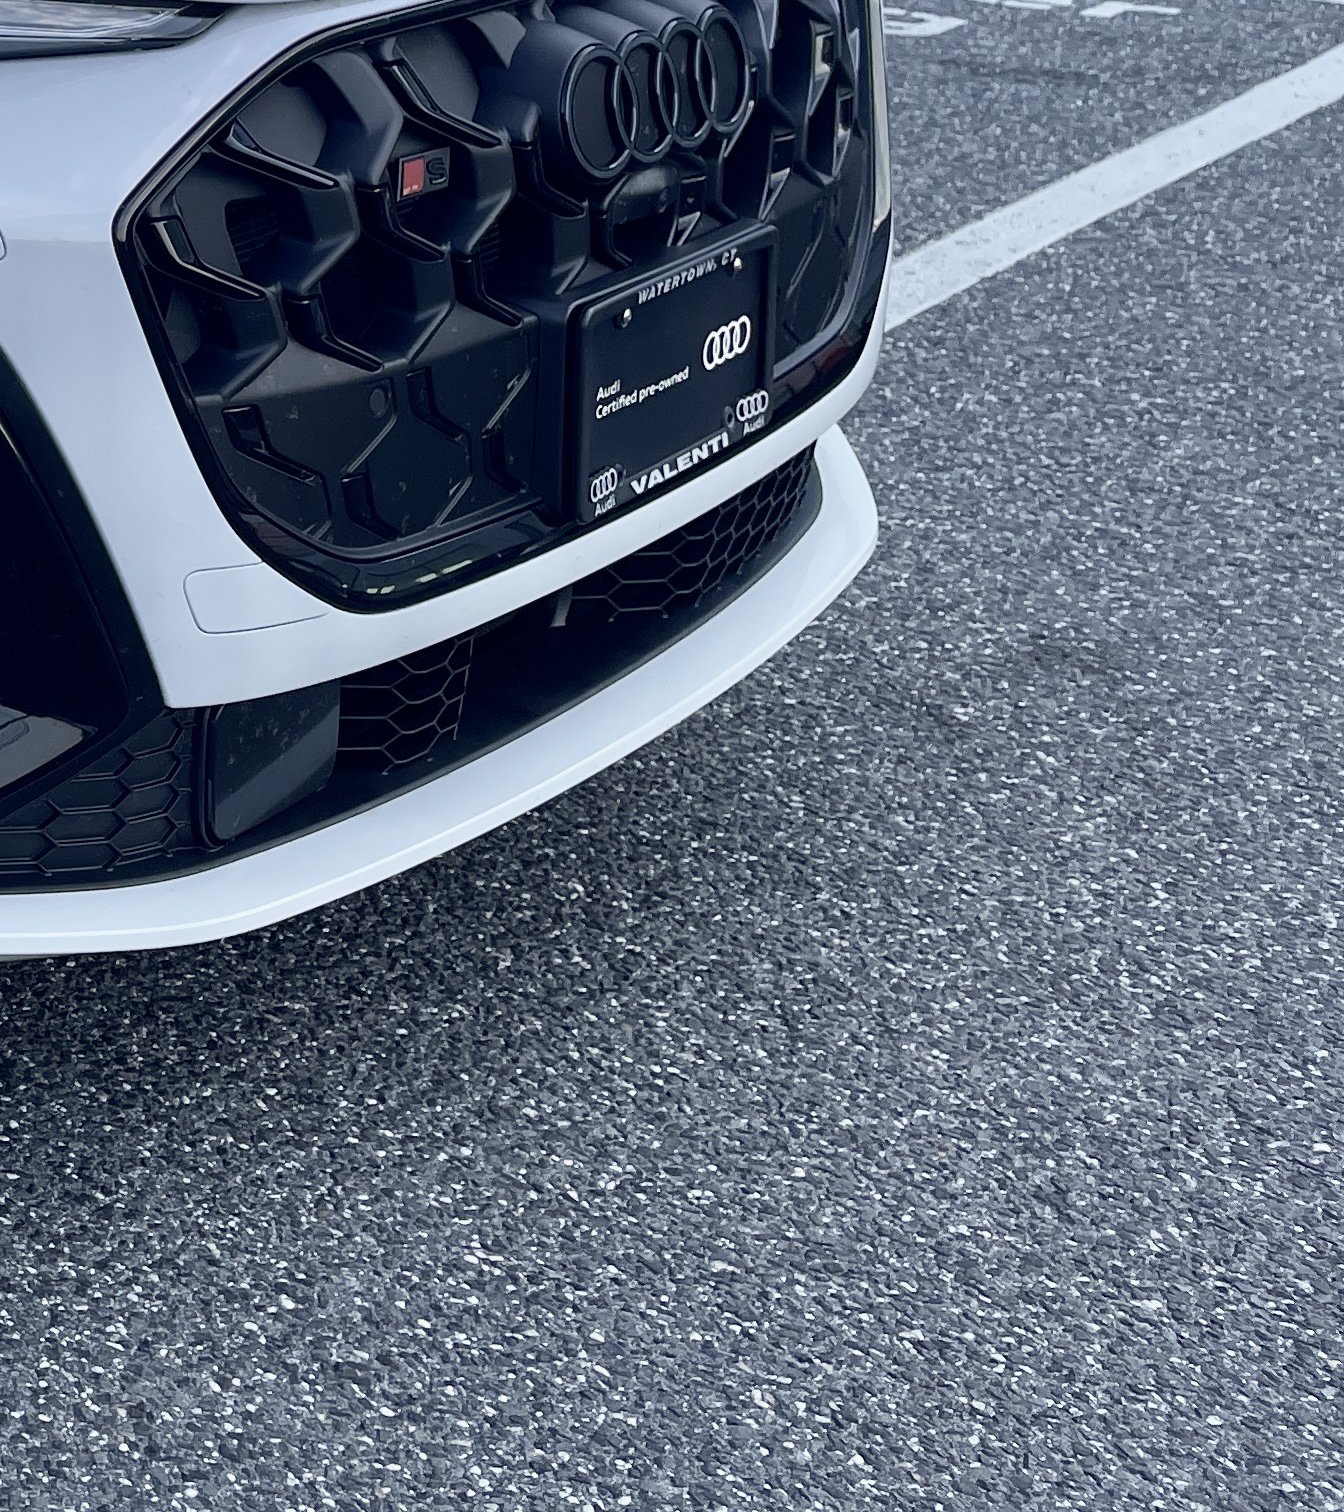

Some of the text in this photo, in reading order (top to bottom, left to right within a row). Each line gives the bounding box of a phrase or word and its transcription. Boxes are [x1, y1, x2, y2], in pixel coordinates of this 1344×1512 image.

[638, 258, 718, 305] WATERTOWN,
[595, 366, 690, 420] Certified pre-owned
[596, 379, 621, 402] Audi
[742, 418, 765, 437] Audi
[630, 432, 729, 496] VALENTI
[594, 497, 616, 517] Audi
